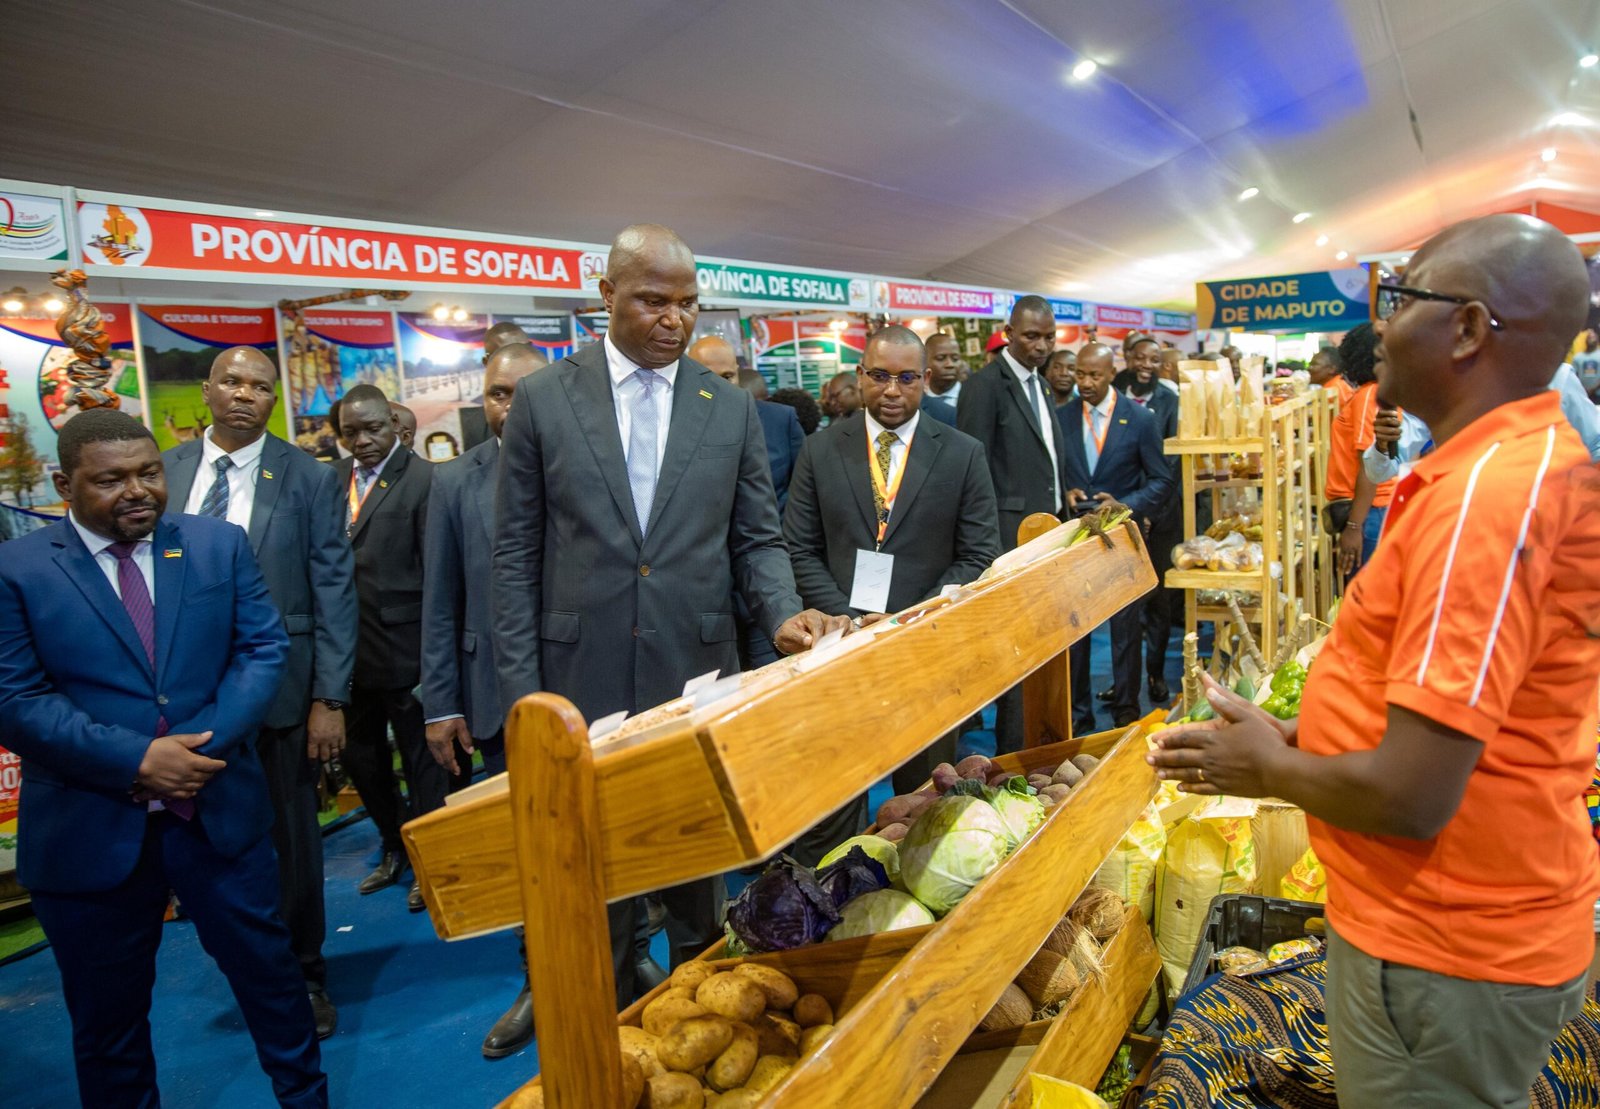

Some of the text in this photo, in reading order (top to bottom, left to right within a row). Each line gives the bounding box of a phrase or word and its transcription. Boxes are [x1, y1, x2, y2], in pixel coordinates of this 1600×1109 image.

[190, 222, 571, 283] PROVÍNCIA DE SOFALA
[696, 265, 845, 301] OVÍNCIA DE SOFALA
[1220, 279, 1300, 301] CIDADE
[895, 286, 948, 306] PROVÍNCIA
[162, 313, 209, 324] CULTURA
[219, 314, 263, 325] TURISMO
[1221, 299, 1346, 323] DE MAPUTO
